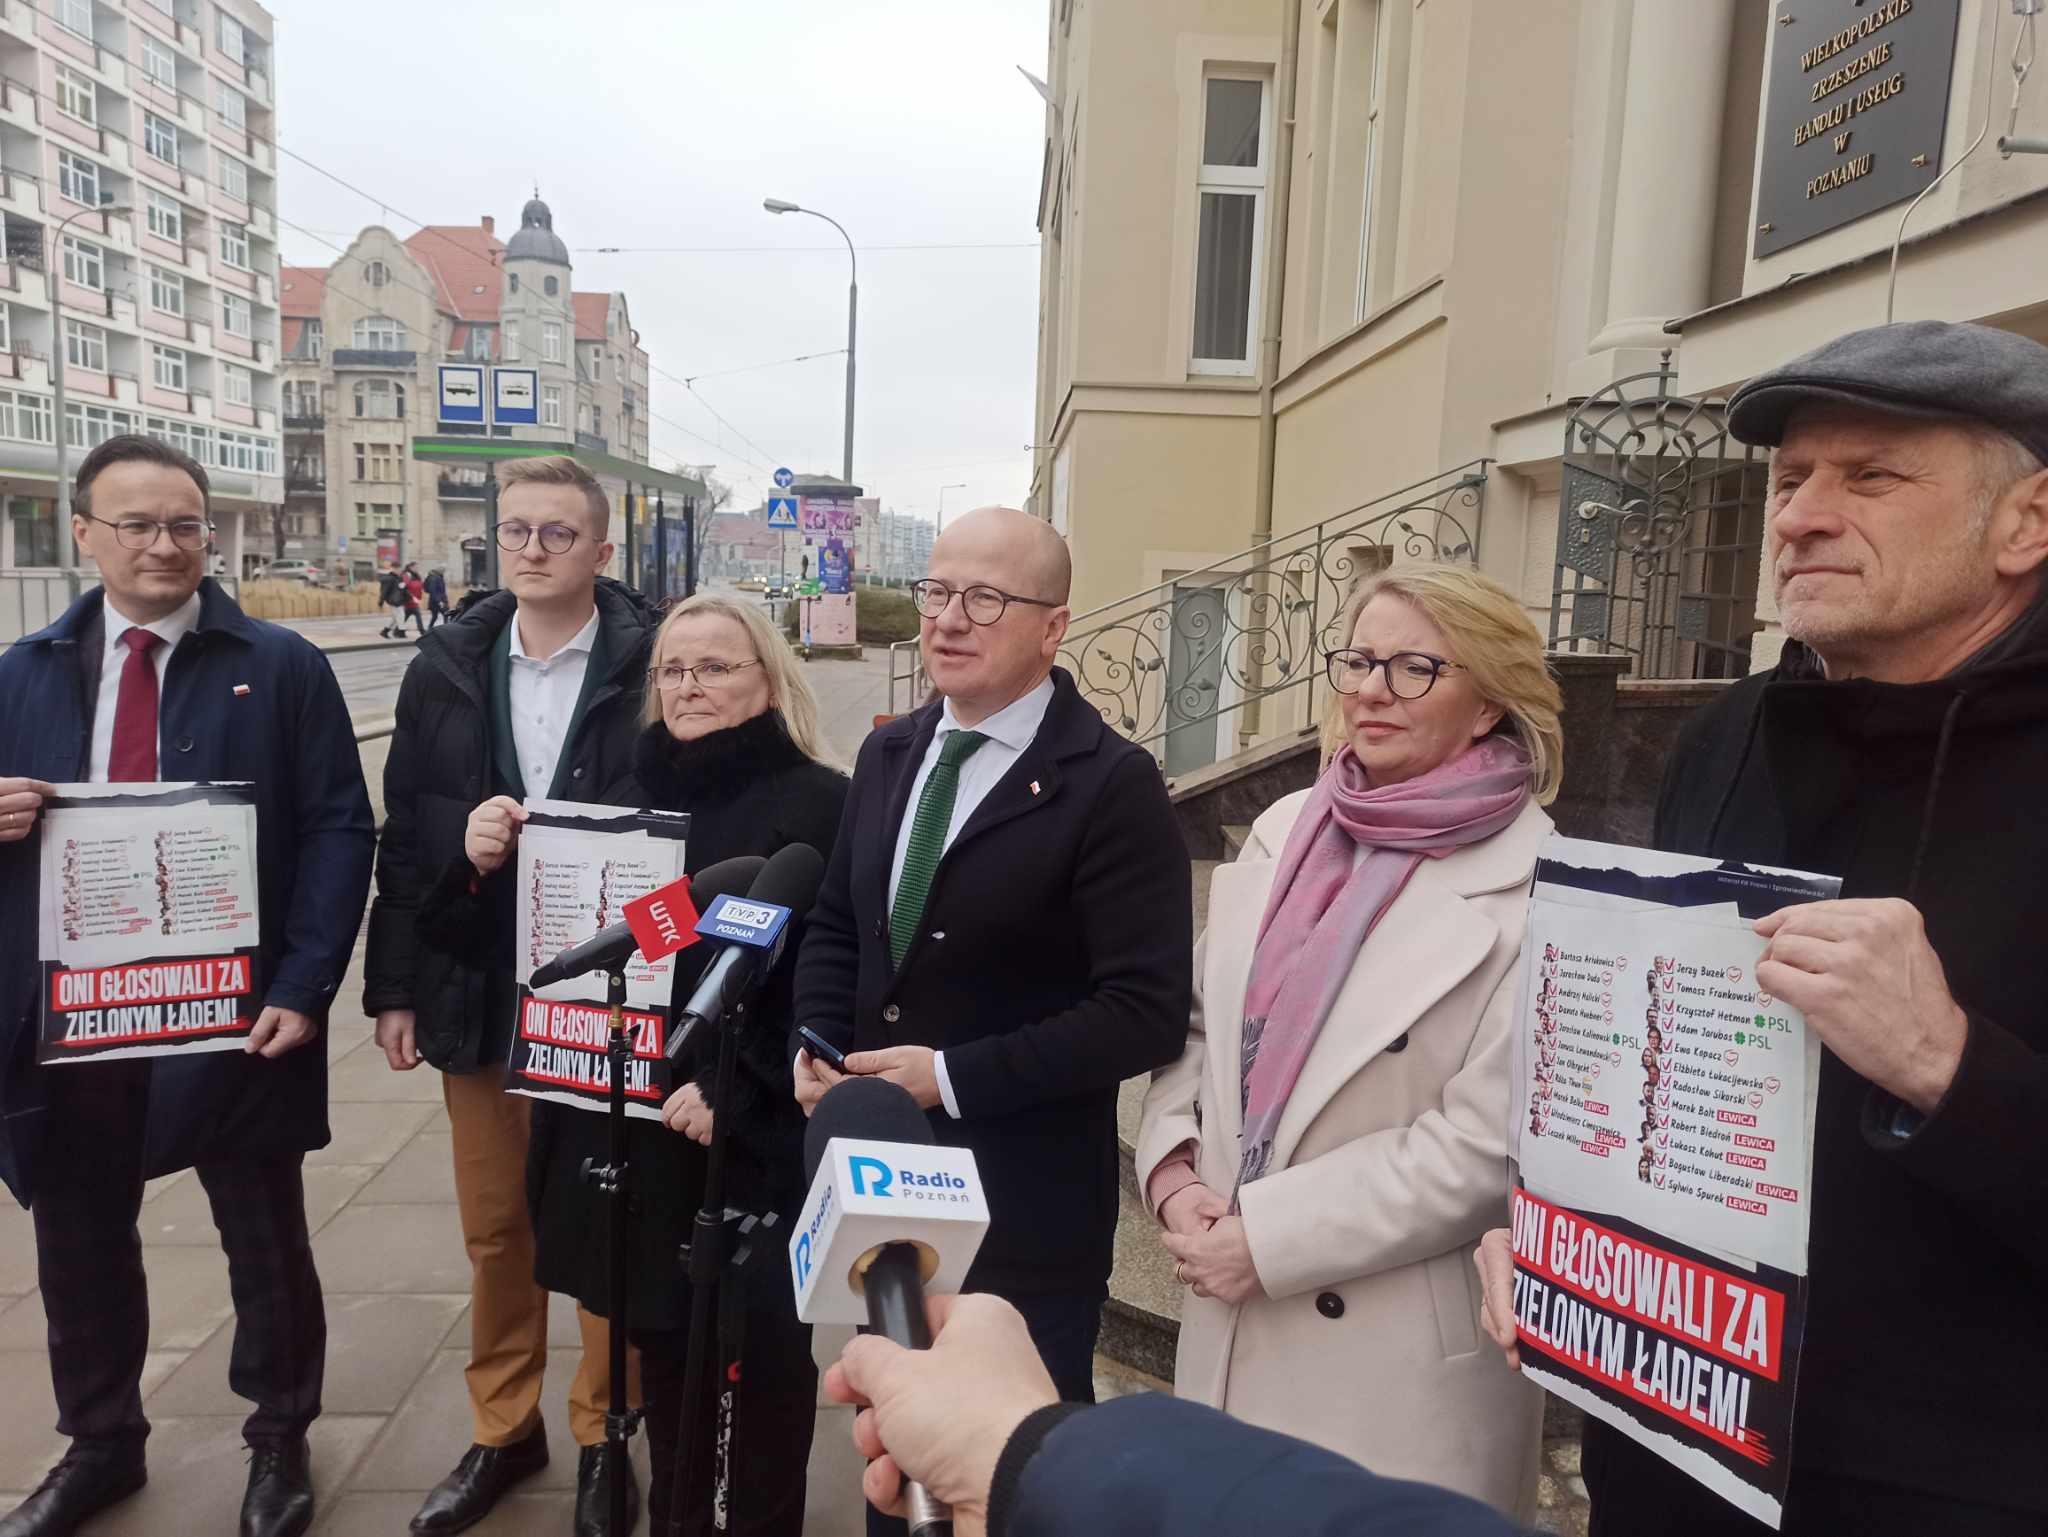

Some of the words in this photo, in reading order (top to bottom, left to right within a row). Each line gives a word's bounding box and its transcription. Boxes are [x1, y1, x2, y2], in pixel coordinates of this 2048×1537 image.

[1800, 0, 1912, 71] WIELKOPOLSKIE
[1811, 42, 1892, 102] ZRZESZENIE
[1794, 104, 1843, 146] HANDLU
[1847, 98, 1853, 118] I
[1857, 74, 1901, 112] USŁUG
[1834, 132, 1849, 153] W
[1807, 154, 1870, 199] POZNANIU
[649, 900, 681, 946] WTK
[59, 972, 95, 1007] ONI
[100, 963, 213, 1003] GŁOSOWALI
[218, 960, 245, 993] ZA
[1676, 963, 1697, 977] Jerzy
[1701, 966, 1725, 978] Buzek
[1676, 982, 1706, 996] Tomasz
[1709, 986, 1756, 1002] Frankowski
[65, 1004, 162, 1041] ZIELONYM
[166, 997, 238, 1032] ŁADEM!
[526, 1001, 549, 1038] ONI
[635, 1017, 657, 1054] ZA
[1676, 1004, 1715, 1019] Krzysztof
[1718, 1011, 1751, 1024] Hetman
[1768, 1017, 1793, 1033] PSL
[1621, 1034, 1641, 1050] PSL
[1674, 1043, 1690, 1055] Ewa
[1694, 1047, 1722, 1061] Kopacz
[1675, 1023, 1698, 1035] Adam
[1701, 1027, 1732, 1041] Jarubas
[1749, 1033, 1773, 1050] PSL
[526, 1042, 591, 1085] ZIELONYM
[593, 1054, 650, 1093] ŁAEM!
[1673, 1063, 1705, 1077] Elżbieta
[1585, 1101, 1608, 1115] LEWICA
[1672, 1081, 1711, 1097] Radosław
[1713, 1089, 1746, 1105] Sikorski
[1671, 1101, 1696, 1114] Marek
[1698, 1105, 1715, 1119] Balt
[1718, 1111, 1756, 1127] LEWICA
[1582, 1141, 1609, 1156] LEWICA
[1596, 1133, 1625, 1148] LEWICA
[1671, 1119, 1697, 1134] Robert
[1700, 1126, 1730, 1142] Biedroń
[1735, 1135, 1774, 1151] LEWICA
[1670, 1138, 1697, 1154] Łukasz
[1700, 1146, 1724, 1161] Kohut
[1727, 1153, 1765, 1169] LEWICA
[899, 1170, 966, 1189] Radio
[903, 1188, 969, 1202] Poznań
[1668, 1158, 1706, 1176] Bogusław
[1709, 1168, 1753, 1189] Liberadzki
[1757, 1184, 1797, 1201] LEWICA
[810, 1184, 832, 1241] Radio
[1667, 1180, 1694, 1195] Sylwia
[1696, 1187, 1724, 1203] Spurek
[1727, 1197, 1766, 1214] LEWICA
[1512, 1194, 1547, 1266] ONI
[1550, 1214, 1714, 1343] GŁOSOWALI
[1722, 1283, 1768, 1368] ZA
[1513, 1268, 1626, 1382] ZIELONYM
[1631, 1330, 1751, 1443] ŁADEM!
